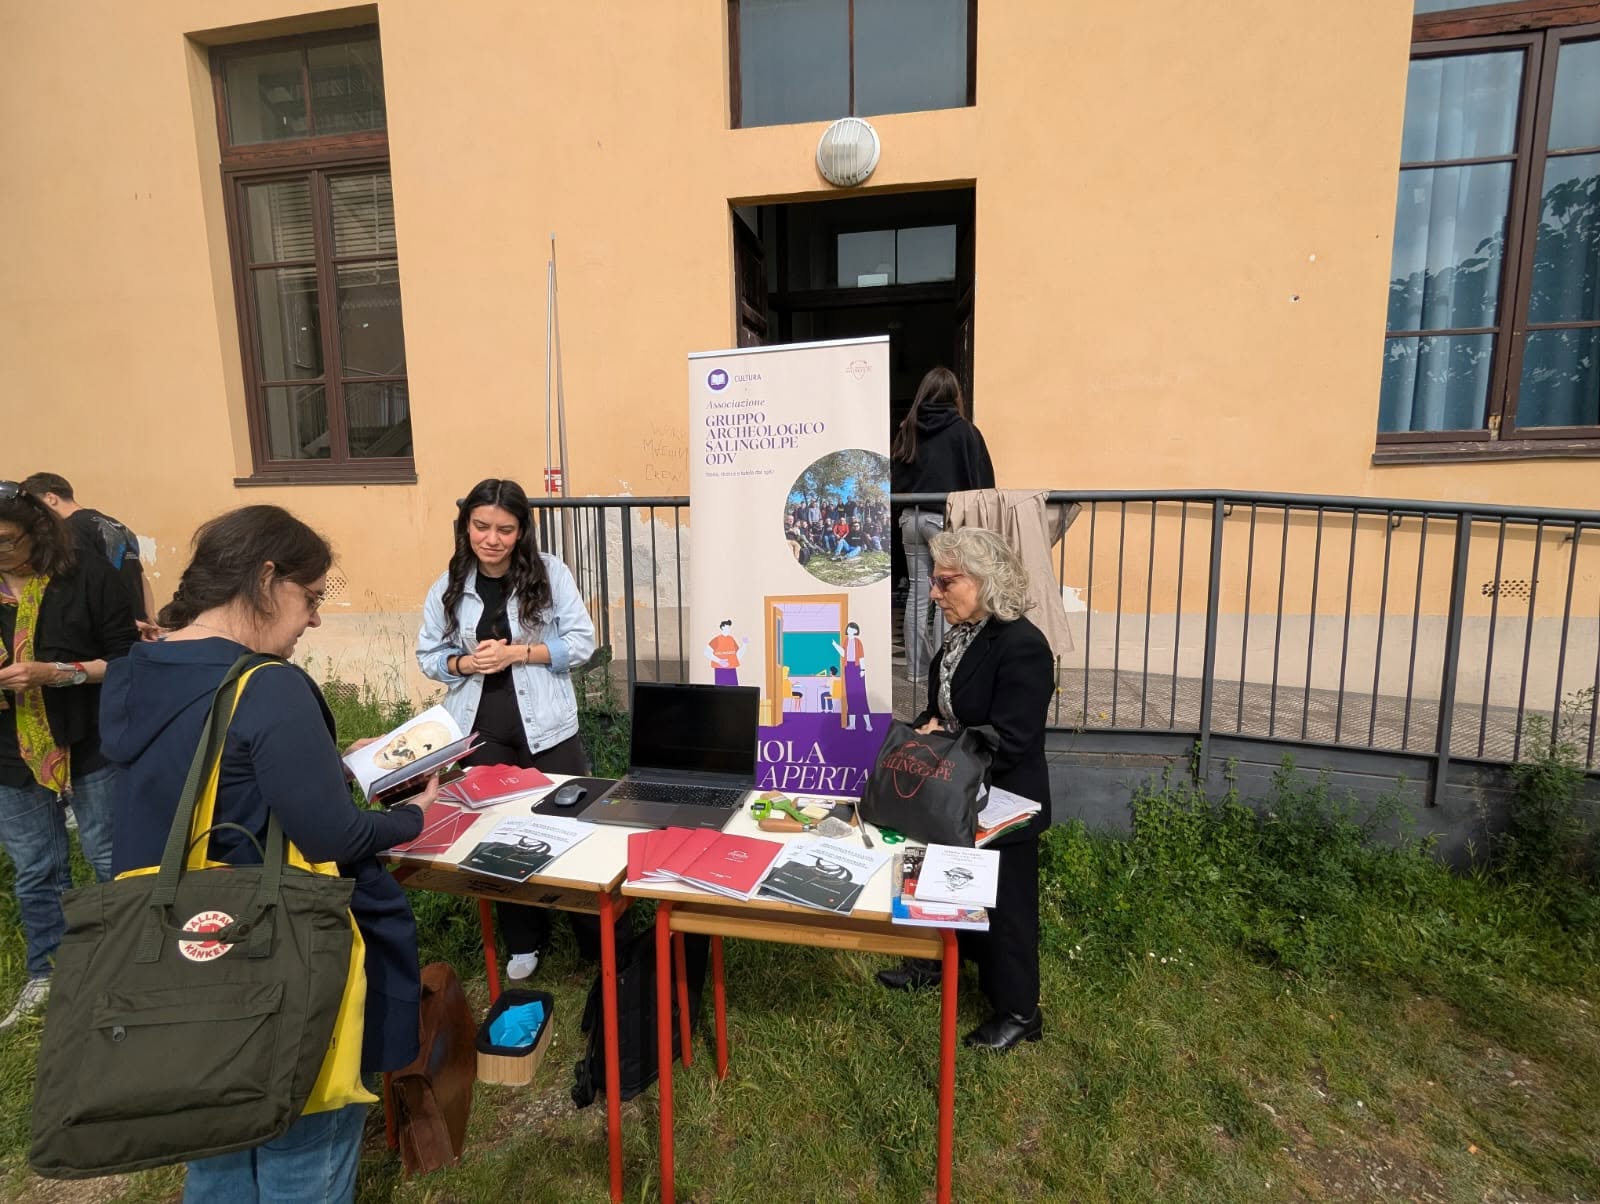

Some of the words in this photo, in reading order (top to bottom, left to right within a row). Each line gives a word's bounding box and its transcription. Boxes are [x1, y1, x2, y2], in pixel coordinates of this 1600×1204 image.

[734, 373, 762, 383] CULTURA
[705, 398, 766, 410] Associazione
[705, 412, 766, 427] GRUPPO
[706, 421, 825, 440] ARCHEOLOGICO
[705, 436, 799, 453] SALINGOLPE
[705, 452, 737, 466] ODV
[757, 765, 871, 791] APERTA
